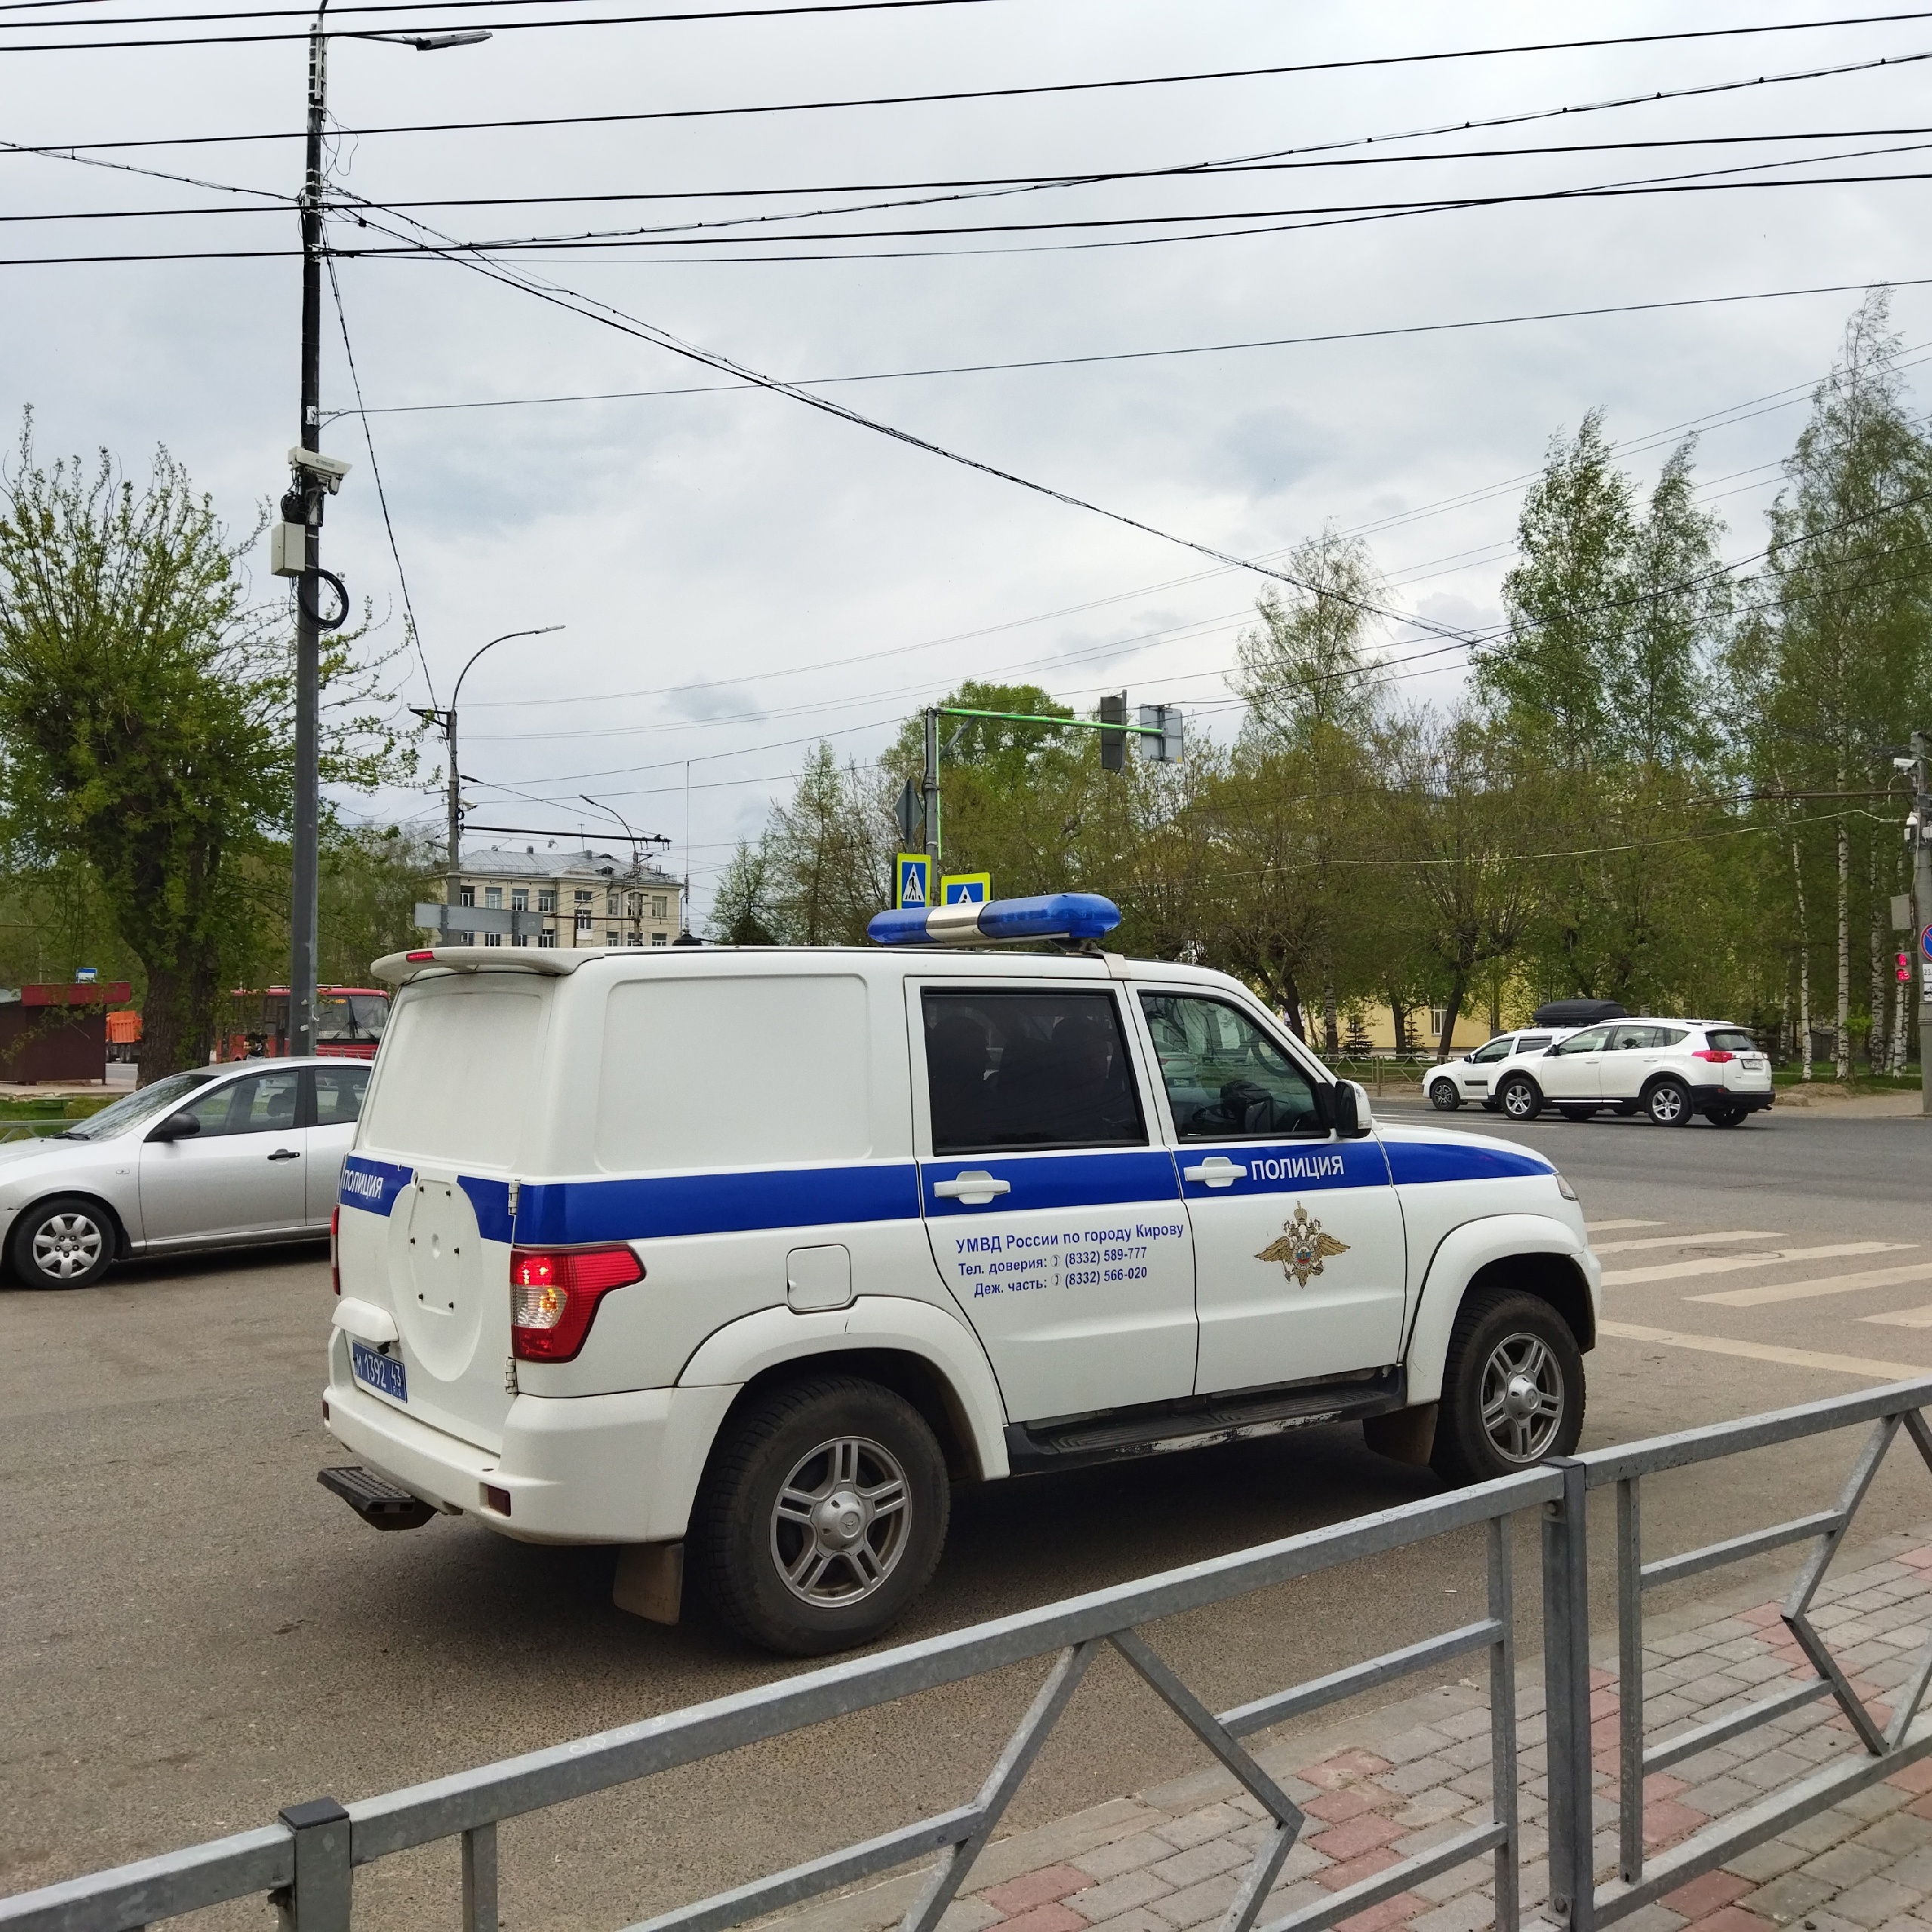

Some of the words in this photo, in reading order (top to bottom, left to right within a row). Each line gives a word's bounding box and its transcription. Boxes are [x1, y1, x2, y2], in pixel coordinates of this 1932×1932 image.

[1251, 1155, 1345, 1180] ПОЛИЦИЯ
[342, 1169, 384, 1200] ПОЛИЦИЯ
[955, 1235, 1002, 1254] УМВД
[1006, 1235, 1059, 1249] России
[1063, 1232, 1080, 1244] по
[1084, 1228, 1131, 1244] городу
[1136, 1224, 1184, 1240] Кирову
[958, 1263, 985, 1275] Тел.
[989, 1258, 1047, 1275] доверия:
[1065, 1251, 1100, 1269] (8332)
[1103, 1247, 1147, 1262] 589-777
[974, 1283, 1004, 1298] Деж.
[1008, 1279, 1047, 1292] часть:
[1065, 1271, 1100, 1289] (8332)
[1103, 1266, 1147, 1281] 566-020
